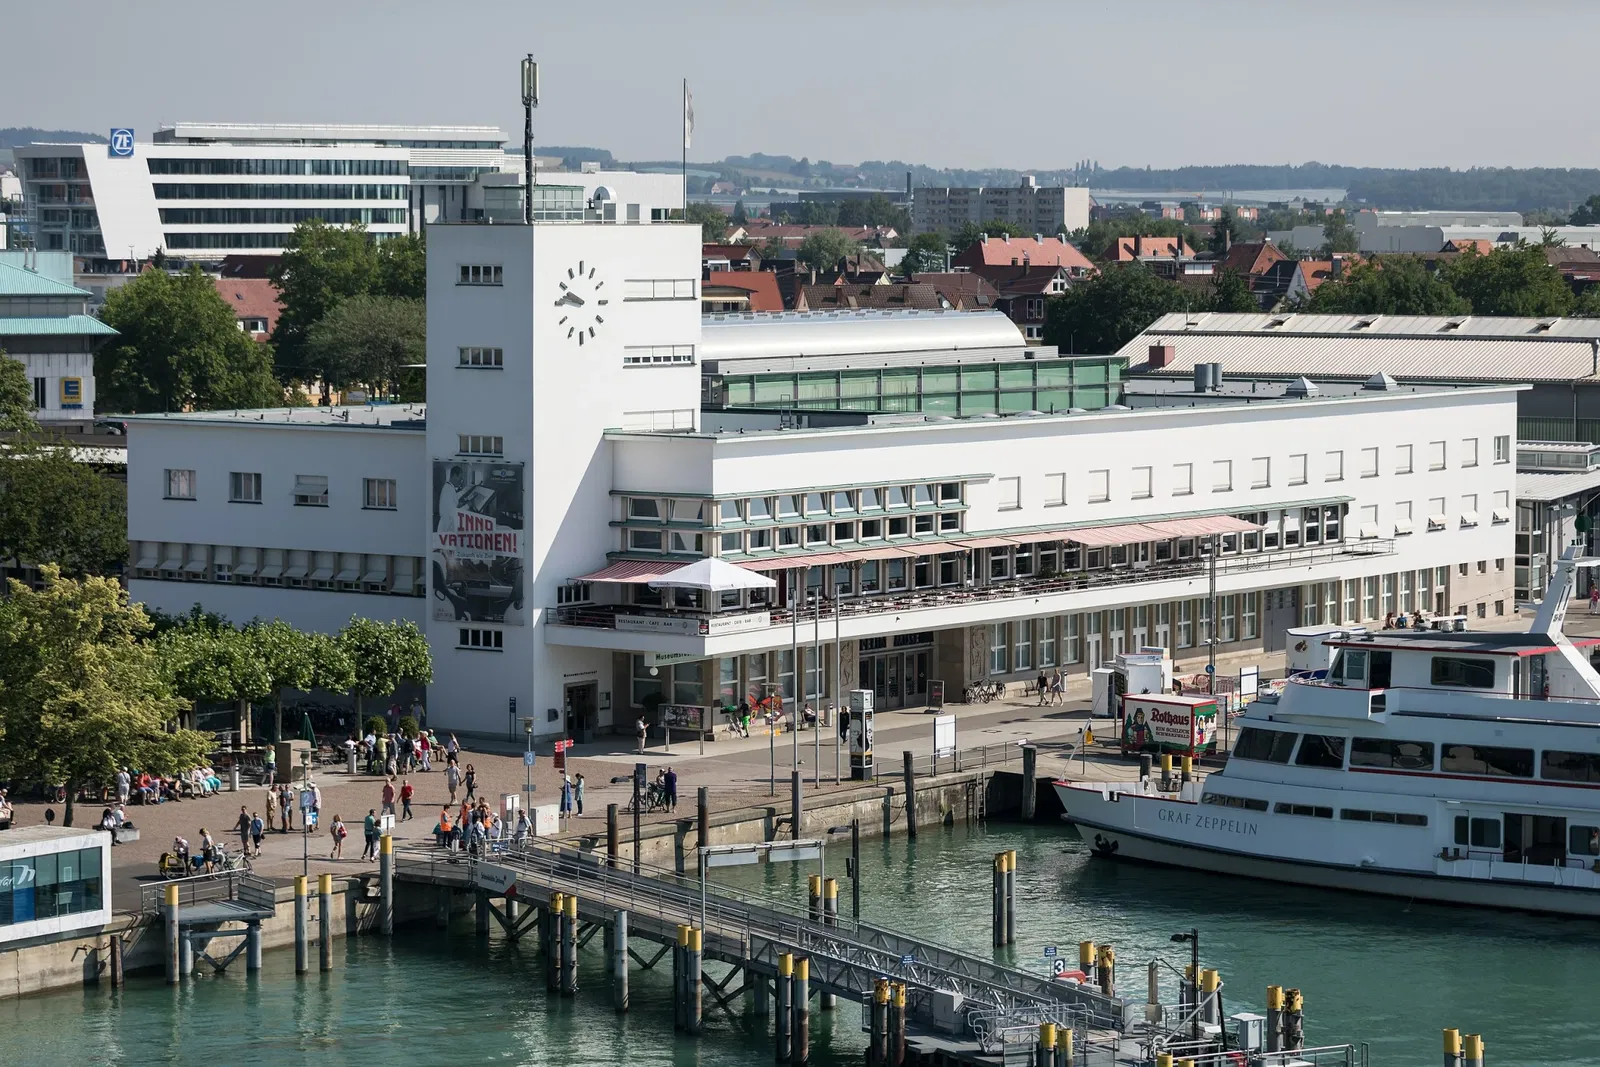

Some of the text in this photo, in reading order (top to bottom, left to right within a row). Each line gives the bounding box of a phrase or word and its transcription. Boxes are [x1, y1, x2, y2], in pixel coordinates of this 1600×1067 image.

[113, 134, 132, 150] ZF
[457, 512, 493, 531] INNO
[439, 533, 517, 553] VATIONEN!
[1150, 707, 1190, 727] Rothaus
[526, 752, 533, 765] 3
[303, 793, 310, 806] 2
[1158, 808, 1258, 836] GRAF ZEPPELIN
[1054, 959, 1064, 976] 3
